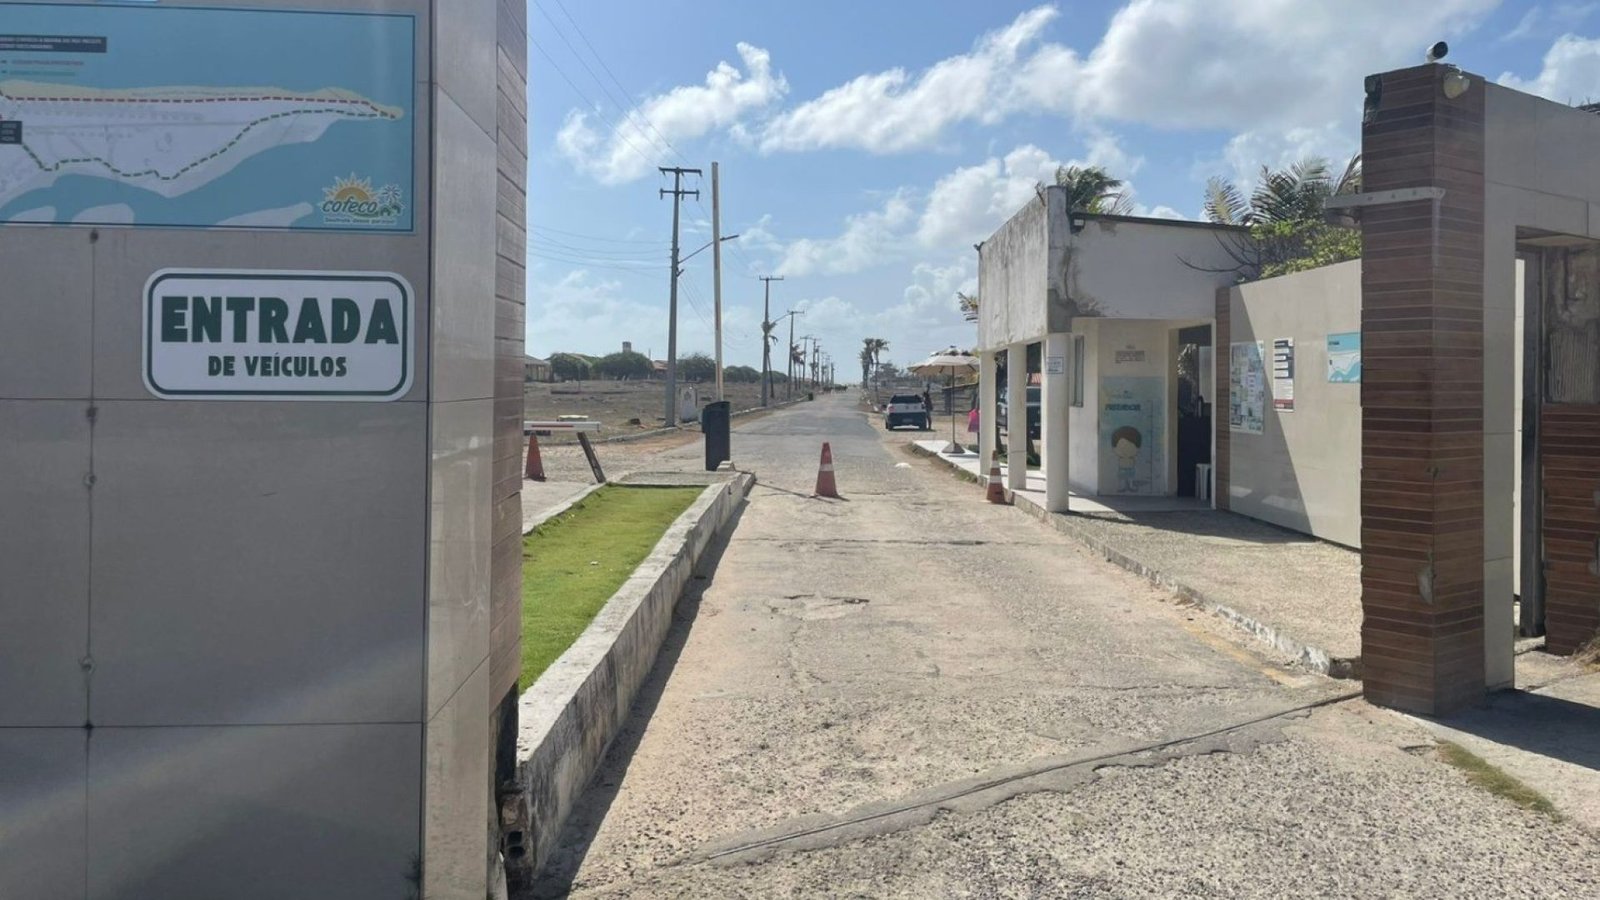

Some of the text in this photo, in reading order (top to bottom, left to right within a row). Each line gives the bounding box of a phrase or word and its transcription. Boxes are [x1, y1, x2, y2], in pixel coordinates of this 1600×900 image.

[323, 196, 377, 213] cofeco
[161, 296, 399, 345] ENTRADA
[208, 352, 347, 377] DE VEÍCULOS
